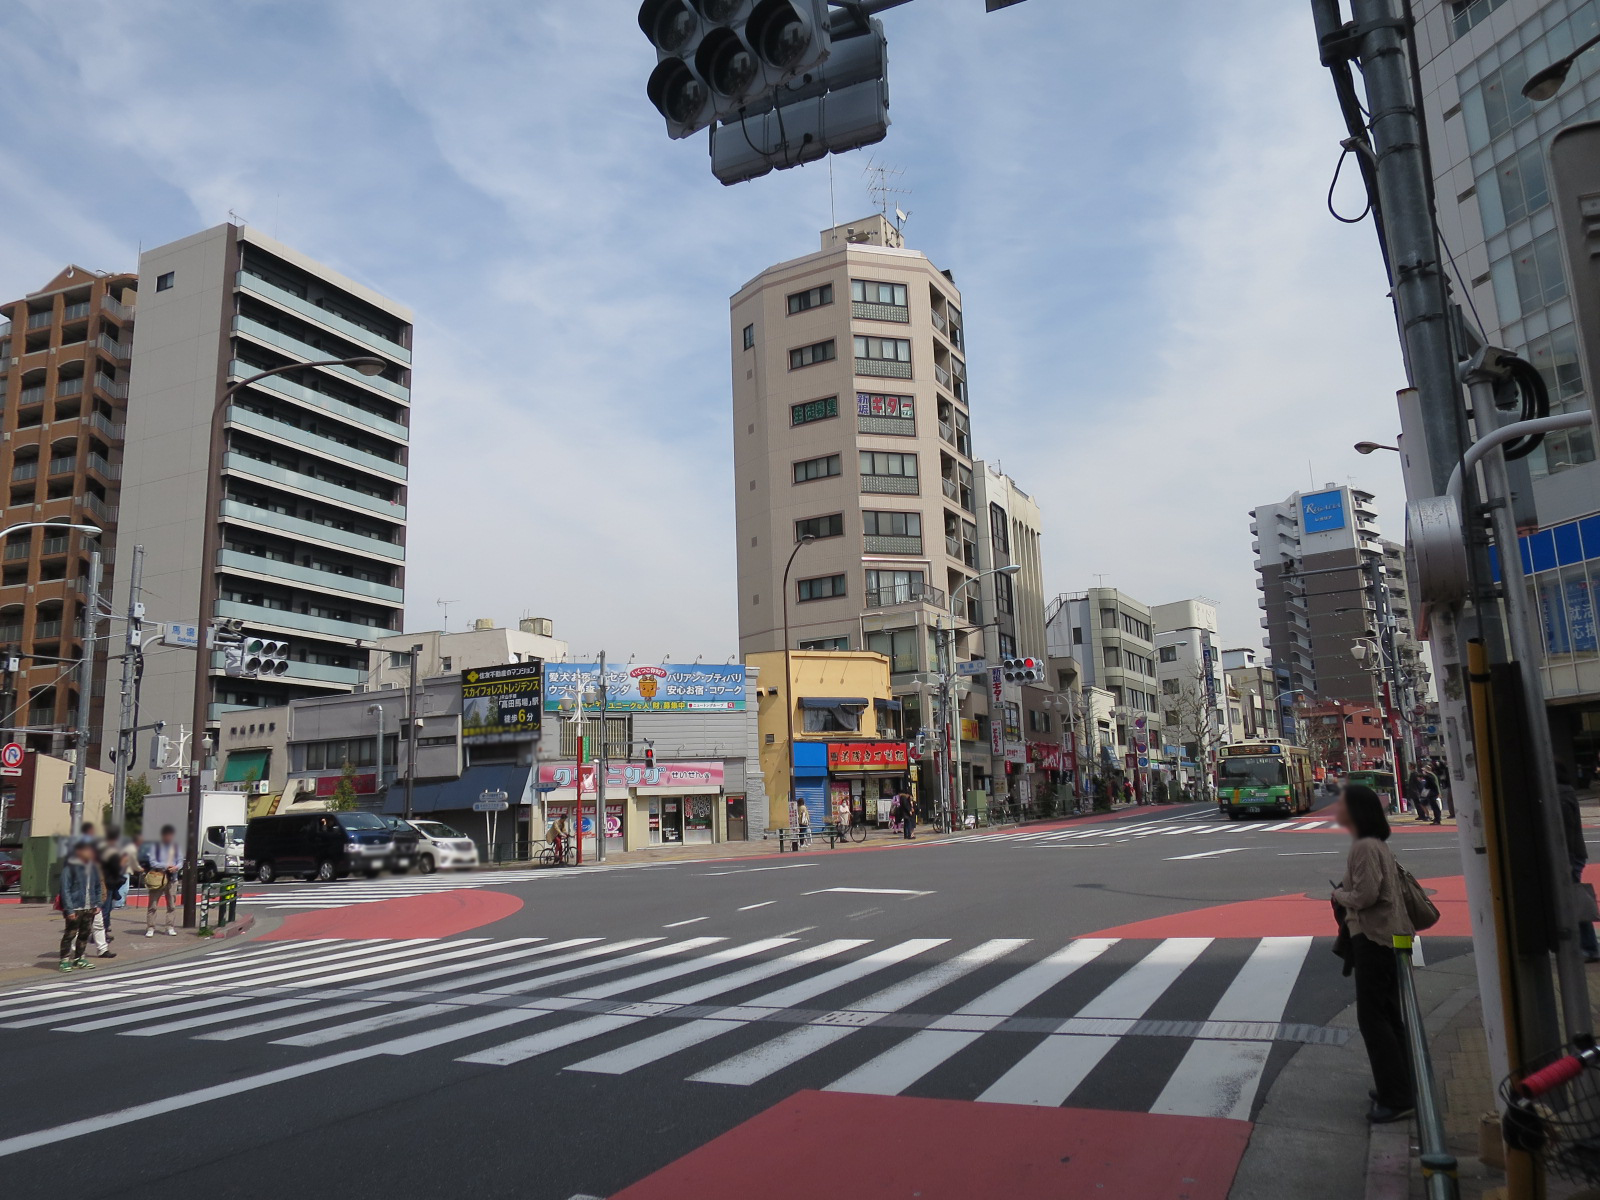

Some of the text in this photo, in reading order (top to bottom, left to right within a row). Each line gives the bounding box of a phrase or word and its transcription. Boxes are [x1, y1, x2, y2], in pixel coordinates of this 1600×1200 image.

[548, 672, 628, 682] 愛犬お宿・セラ
[463, 681, 540, 698] スカイフォレストレジデンス
[553, 766, 666, 786] クニング
